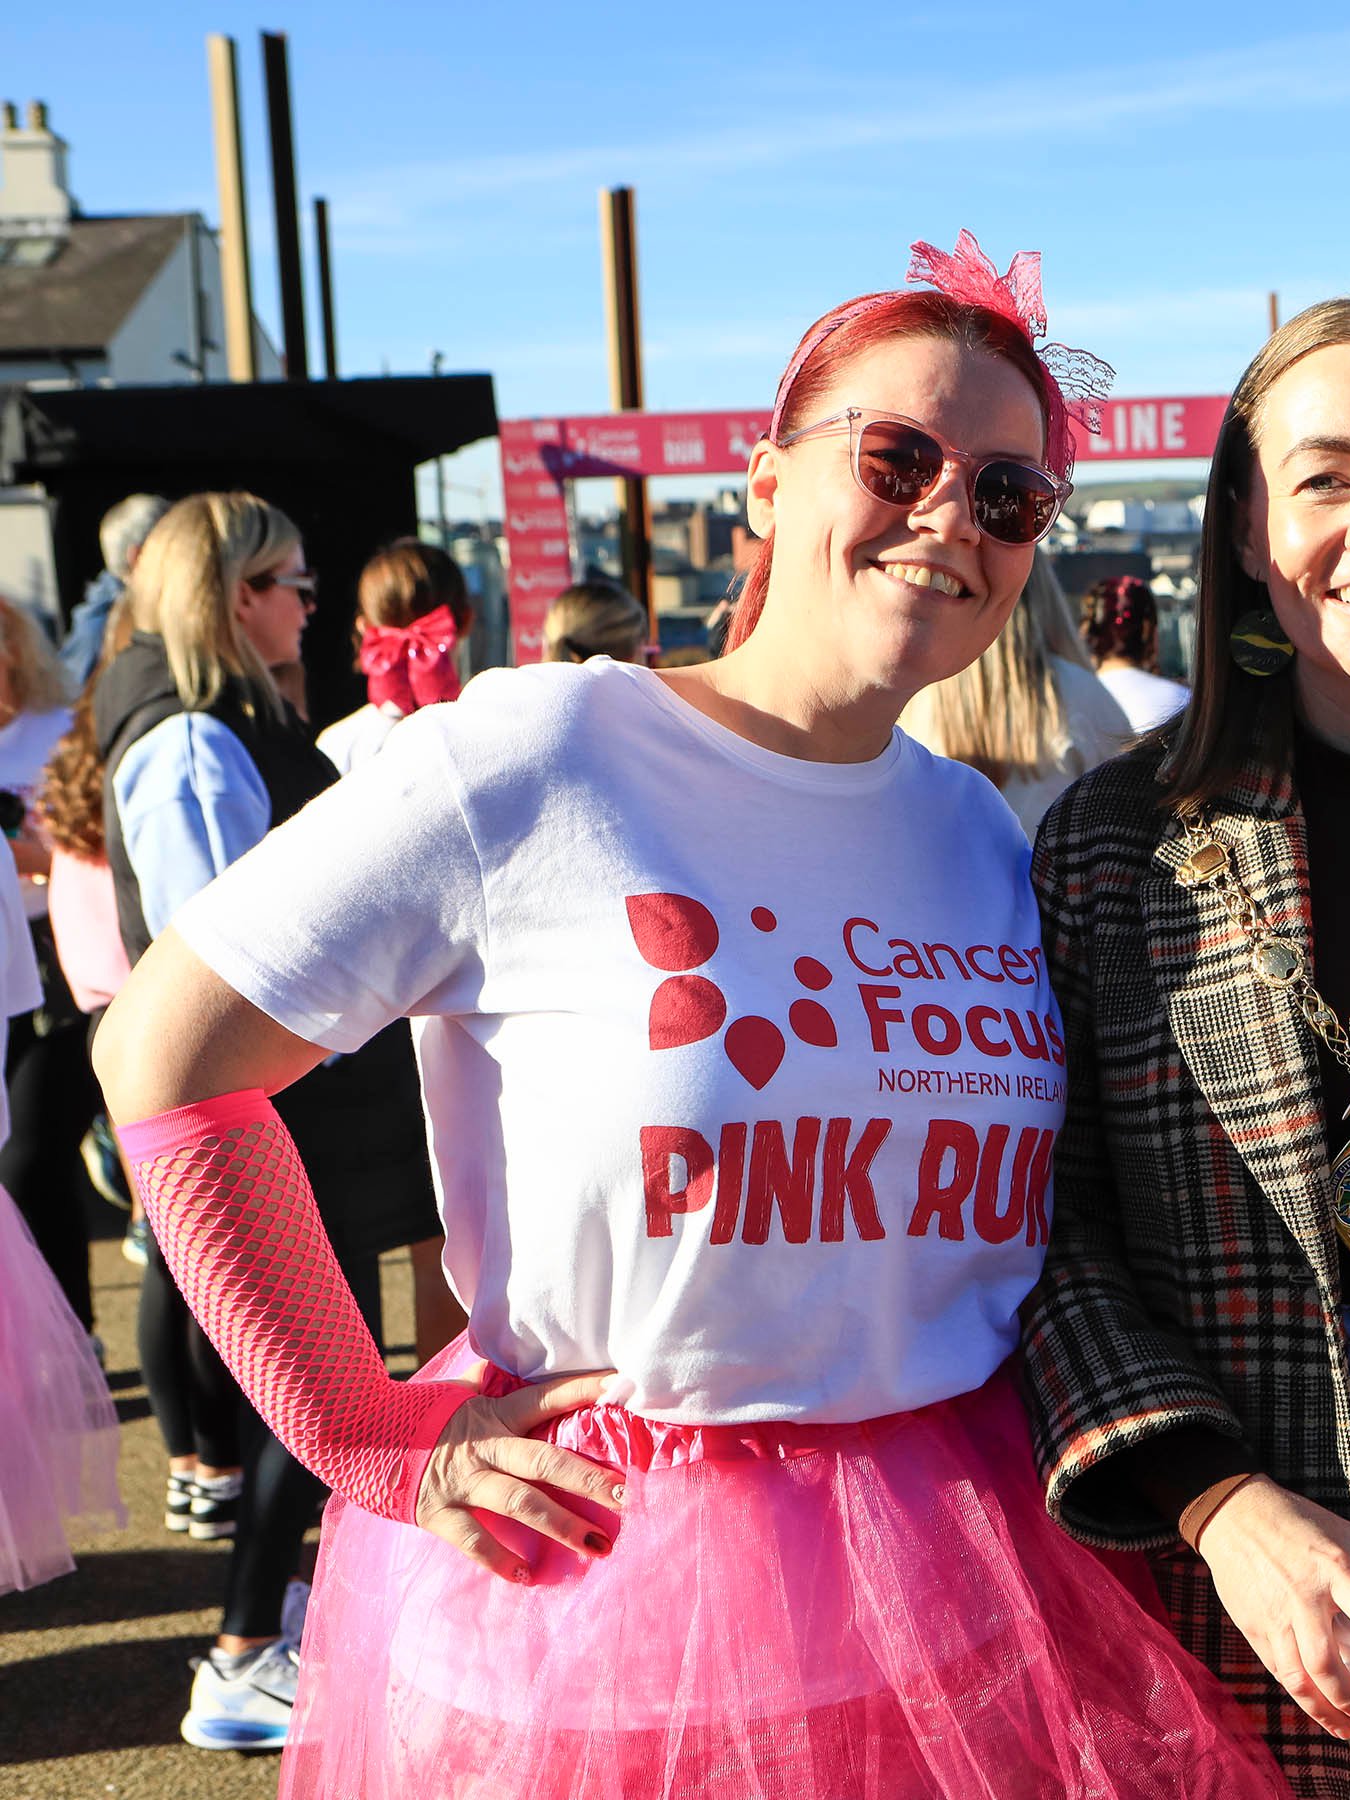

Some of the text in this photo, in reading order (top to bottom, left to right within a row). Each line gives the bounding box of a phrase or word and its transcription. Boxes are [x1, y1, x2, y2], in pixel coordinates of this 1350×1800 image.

[842, 917, 1041, 987] Cancer
[858, 983, 1065, 1067] Focus
[878, 1068, 1066, 1105] NORTHERN IRELAN
[640, 1116, 892, 1246] PINK
